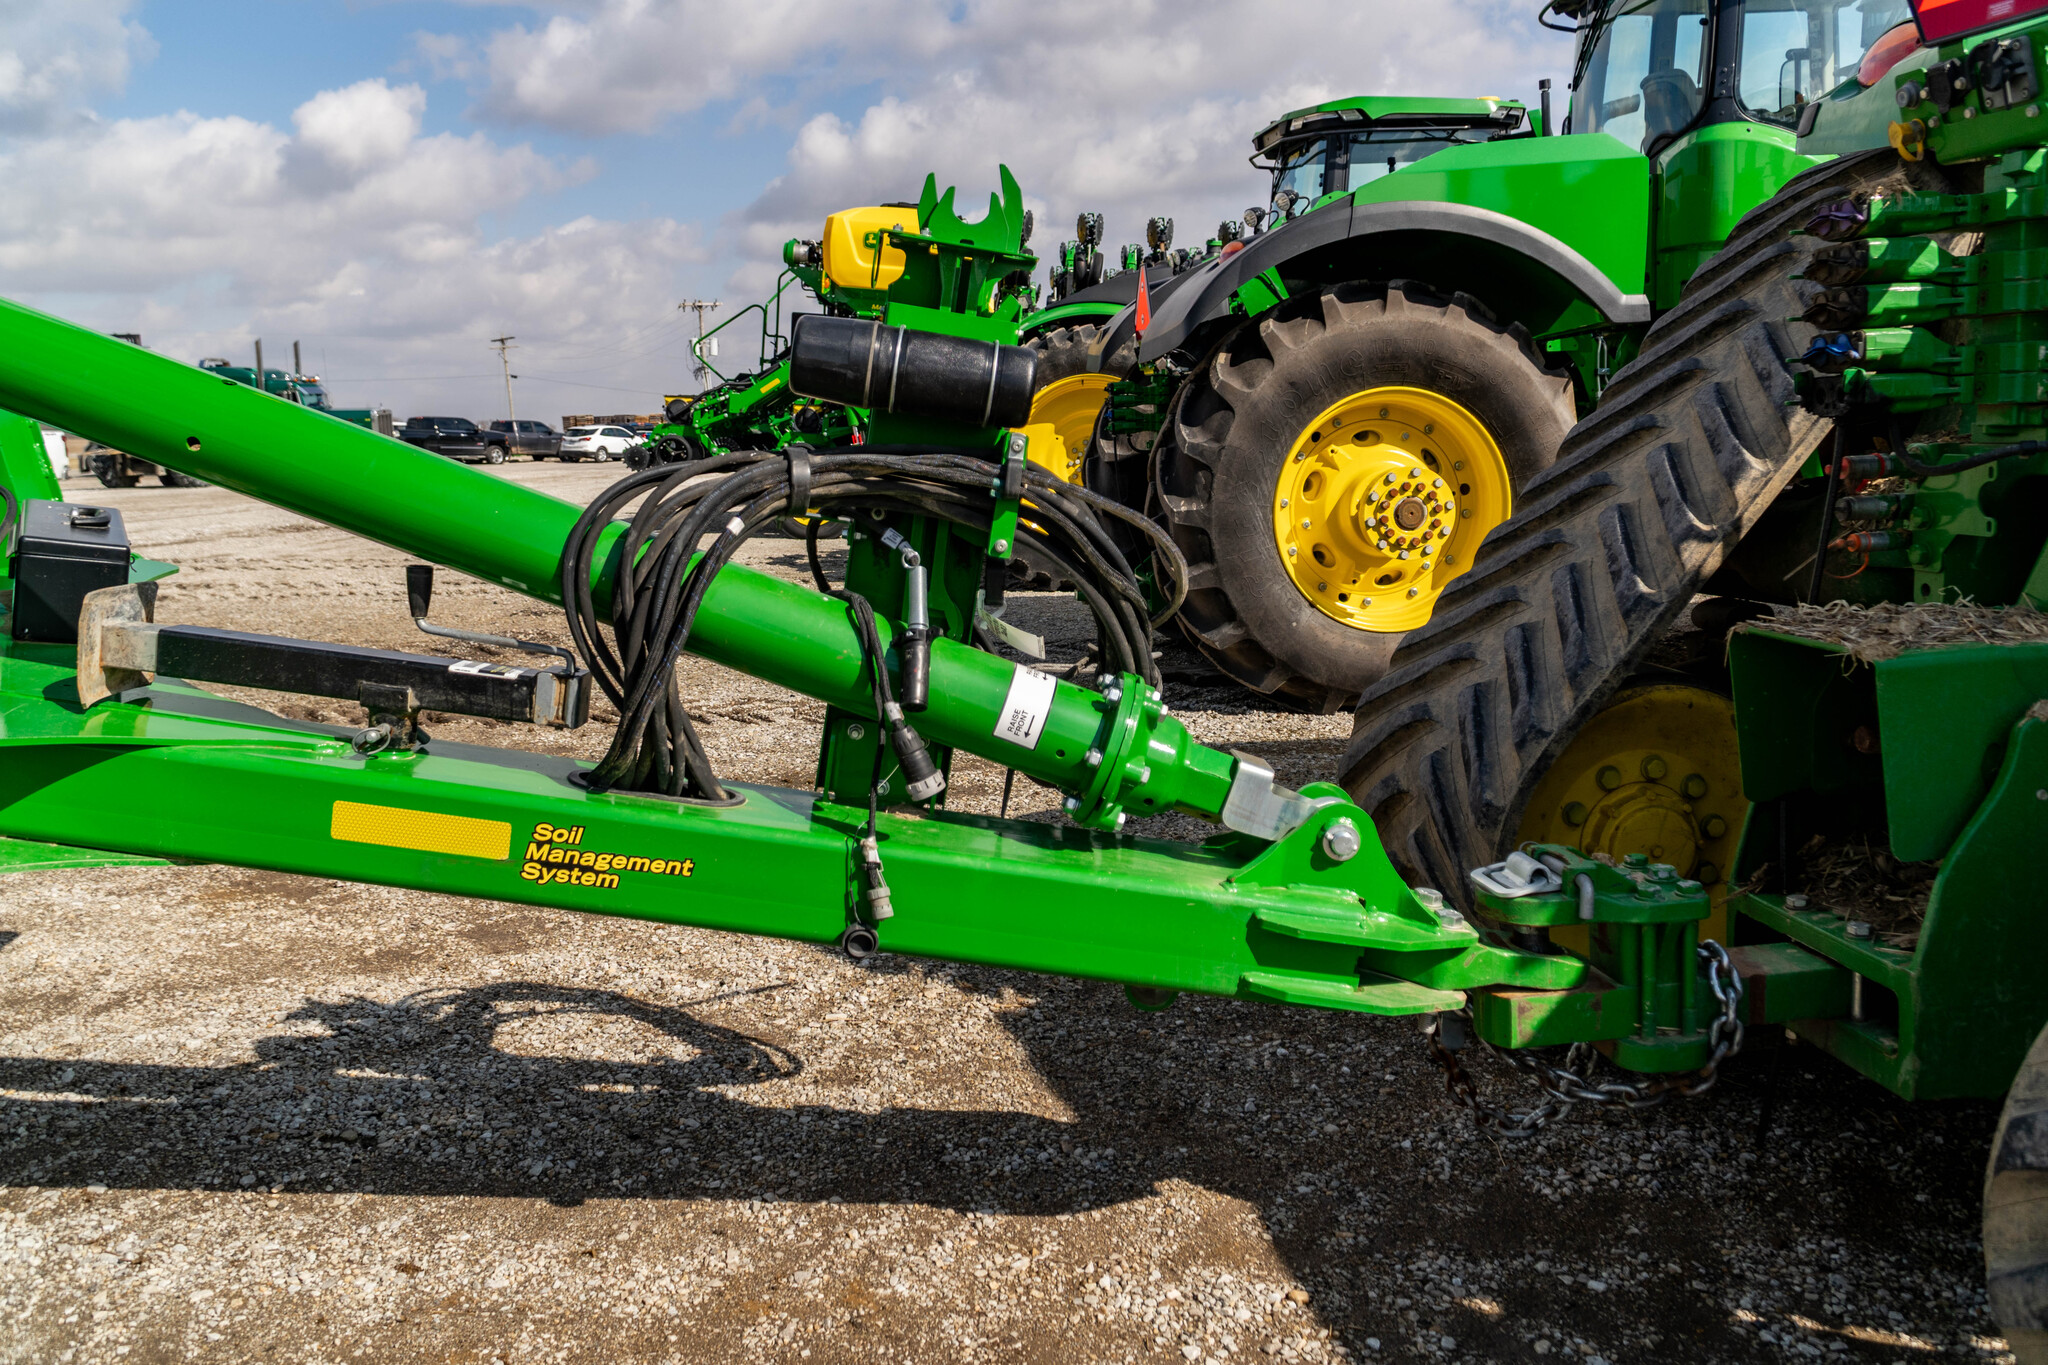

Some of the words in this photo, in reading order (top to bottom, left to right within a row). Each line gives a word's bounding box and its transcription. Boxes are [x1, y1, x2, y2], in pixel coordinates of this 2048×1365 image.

[1007, 708, 1021, 733] RAISE
[1013, 709, 1028, 737] FRONT
[532, 822, 585, 845] Soil
[524, 841, 695, 877] Management
[520, 861, 620, 889] System
